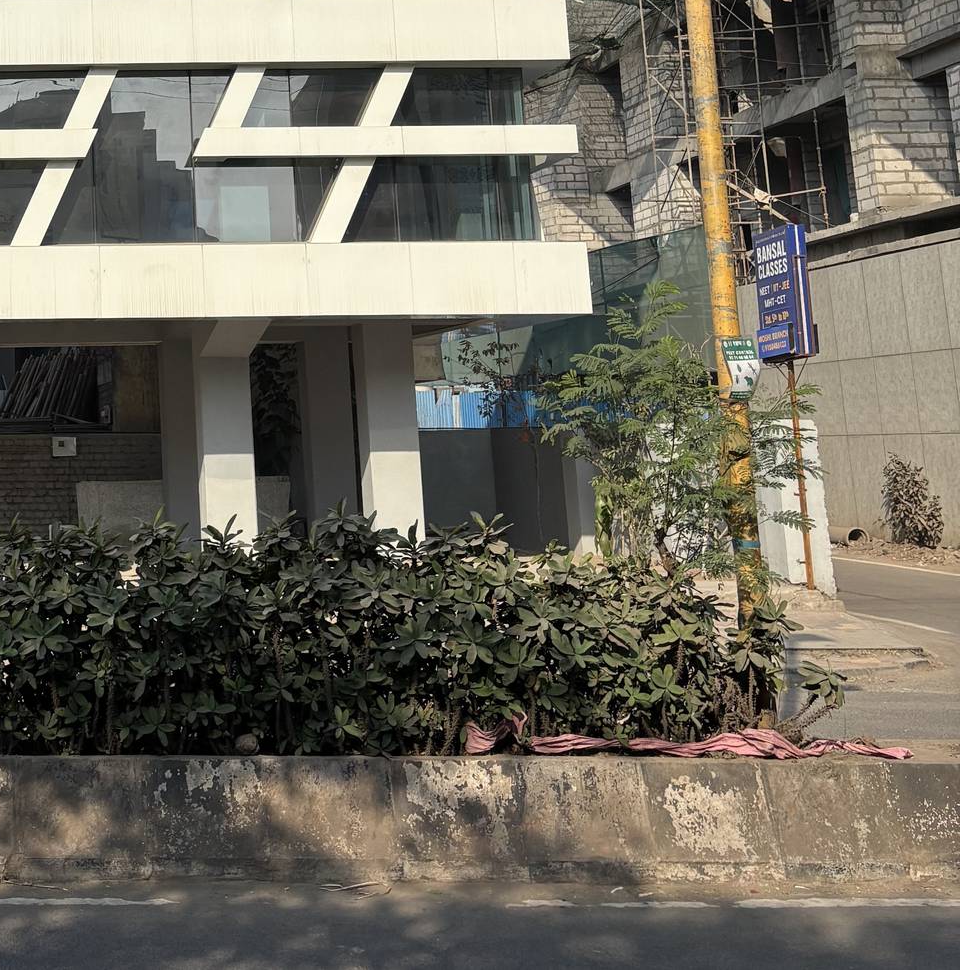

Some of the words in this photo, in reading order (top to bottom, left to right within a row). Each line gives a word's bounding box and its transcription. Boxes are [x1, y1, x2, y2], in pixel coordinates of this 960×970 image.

[756, 240, 787, 264] BANSAL
[758, 258, 788, 280] CLASSES
[764, 294, 786, 308] MHT-CET
